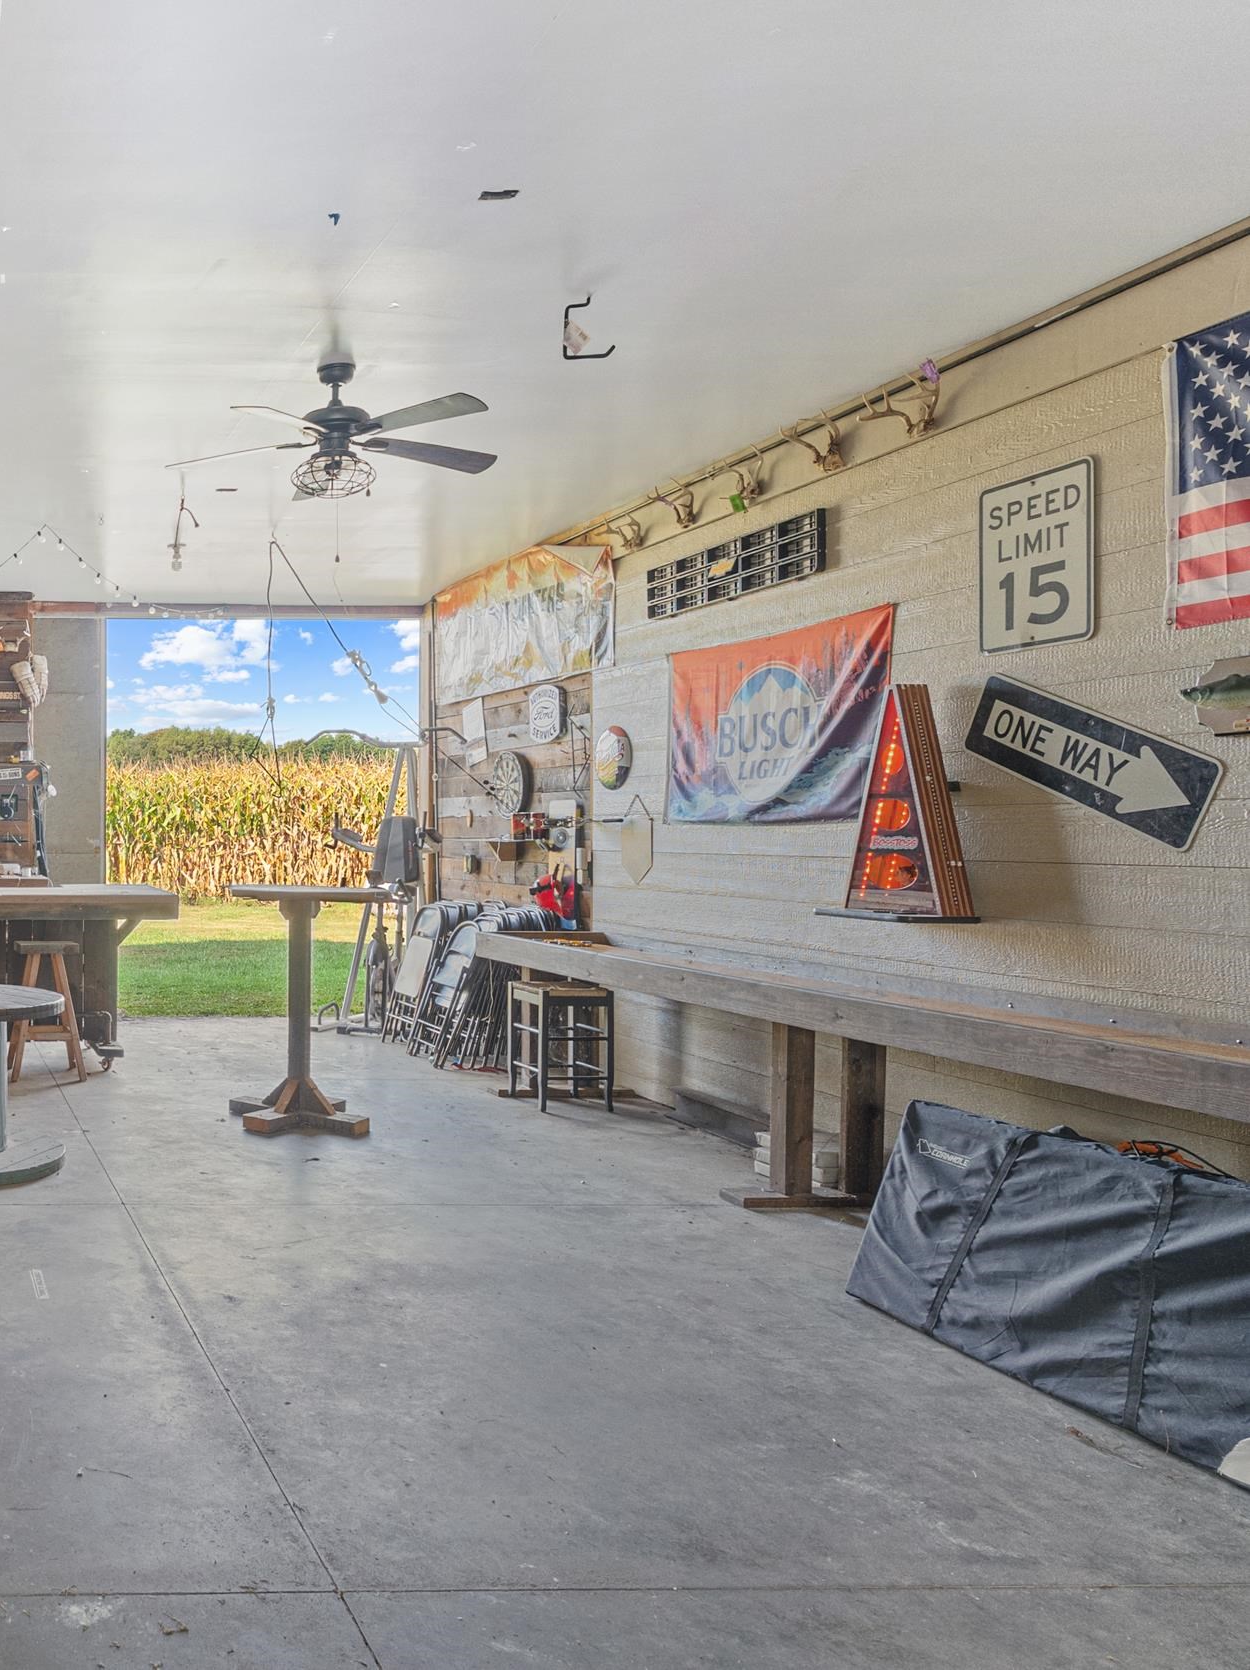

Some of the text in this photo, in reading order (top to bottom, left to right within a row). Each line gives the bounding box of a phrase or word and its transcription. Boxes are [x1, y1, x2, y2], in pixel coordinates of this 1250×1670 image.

[988, 484, 1081, 531] SPEED
[998, 521, 1070, 563] LIMIT
[999, 559, 1070, 631] 15
[532, 723, 557, 739] SERVICE
[533, 706, 554, 721] Ford
[717, 700, 826, 757] BUSCH
[737, 756, 794, 781] LIGHT
[993, 709, 1130, 787] ONE WAY
[931, 1149, 969, 1166] CORNHOLE
